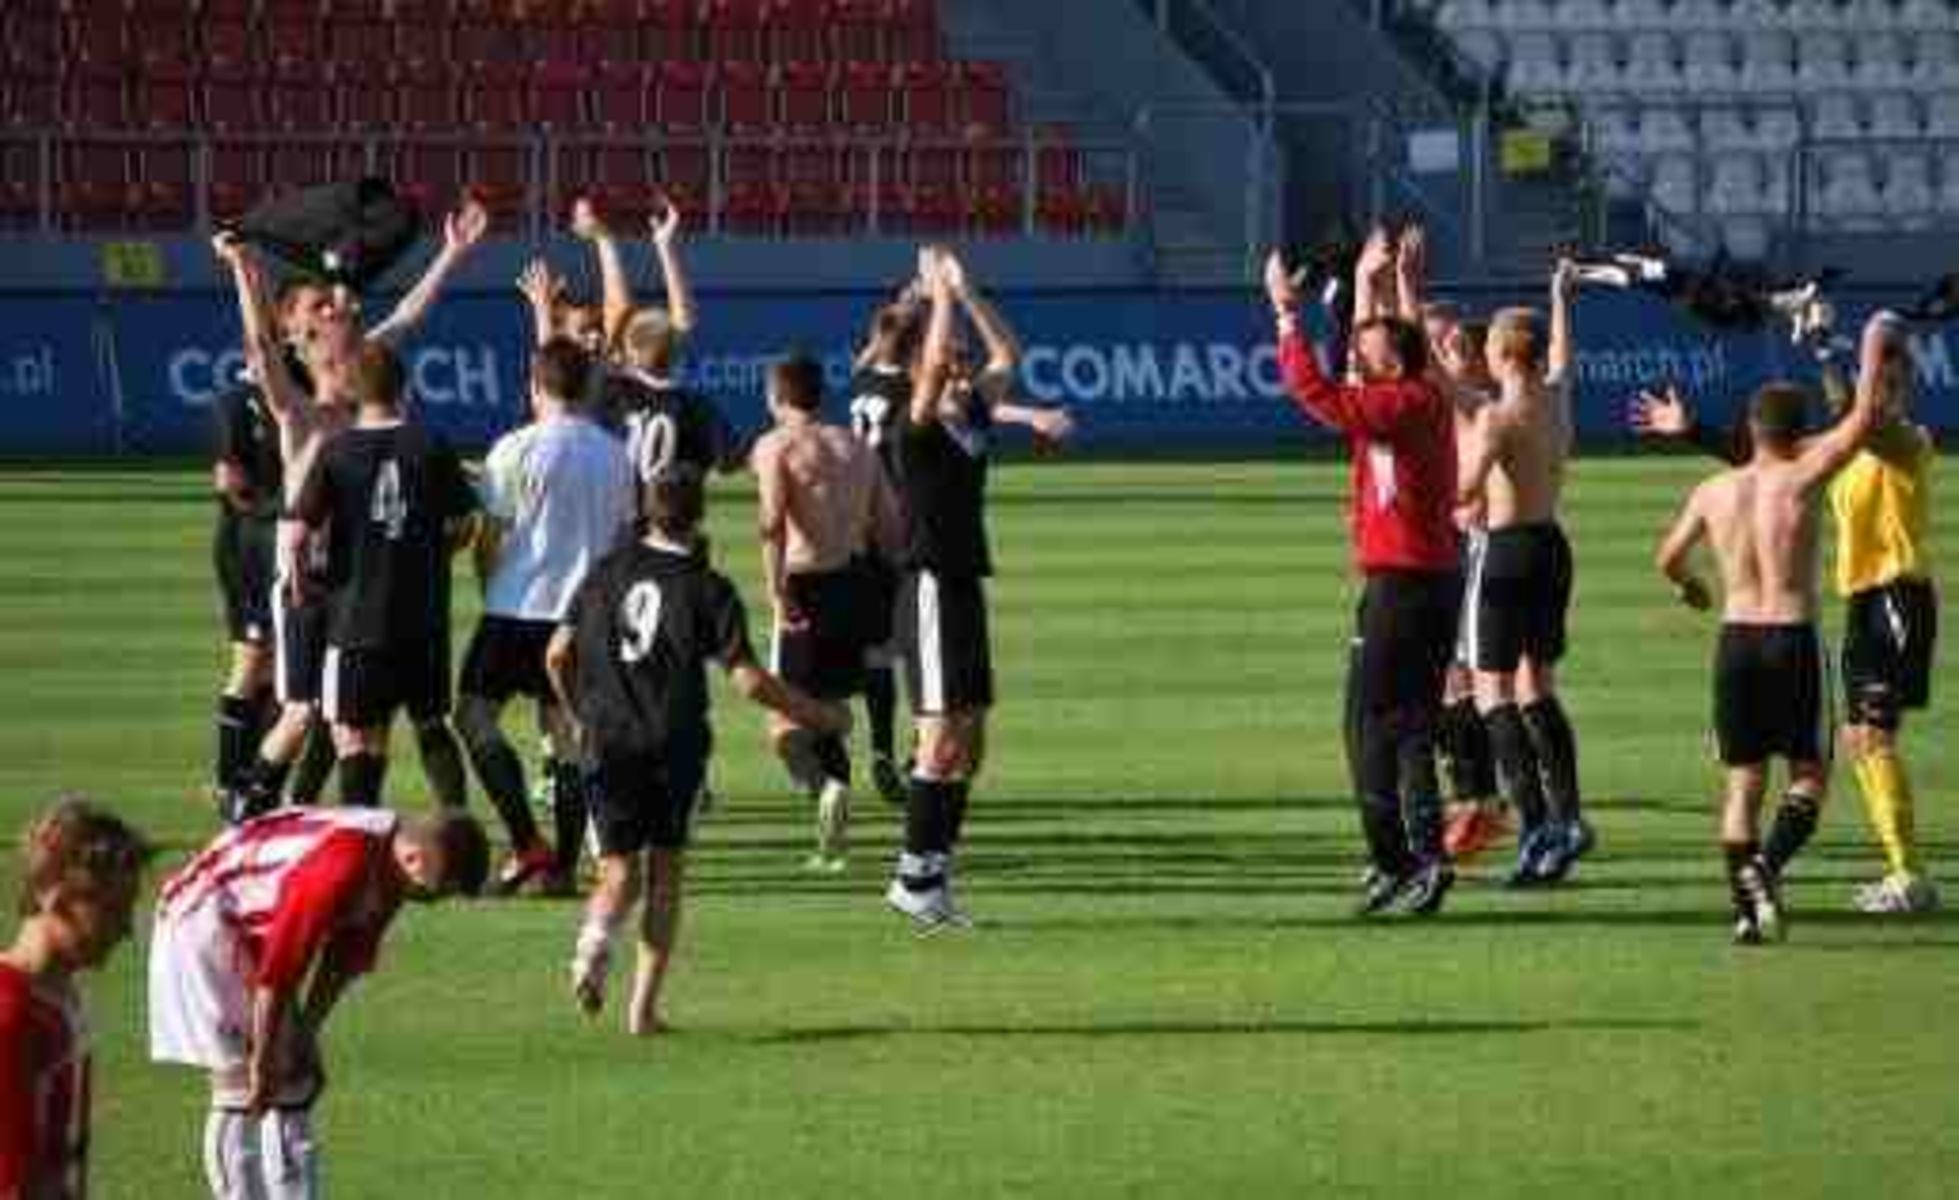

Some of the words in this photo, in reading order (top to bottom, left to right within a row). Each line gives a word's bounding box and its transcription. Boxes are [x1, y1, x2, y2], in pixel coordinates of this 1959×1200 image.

[170, 347, 501, 405] COCH
[1021, 342, 1330, 403] COMARC
[371, 458, 407, 541] 4
[620, 579, 662, 662] 9
